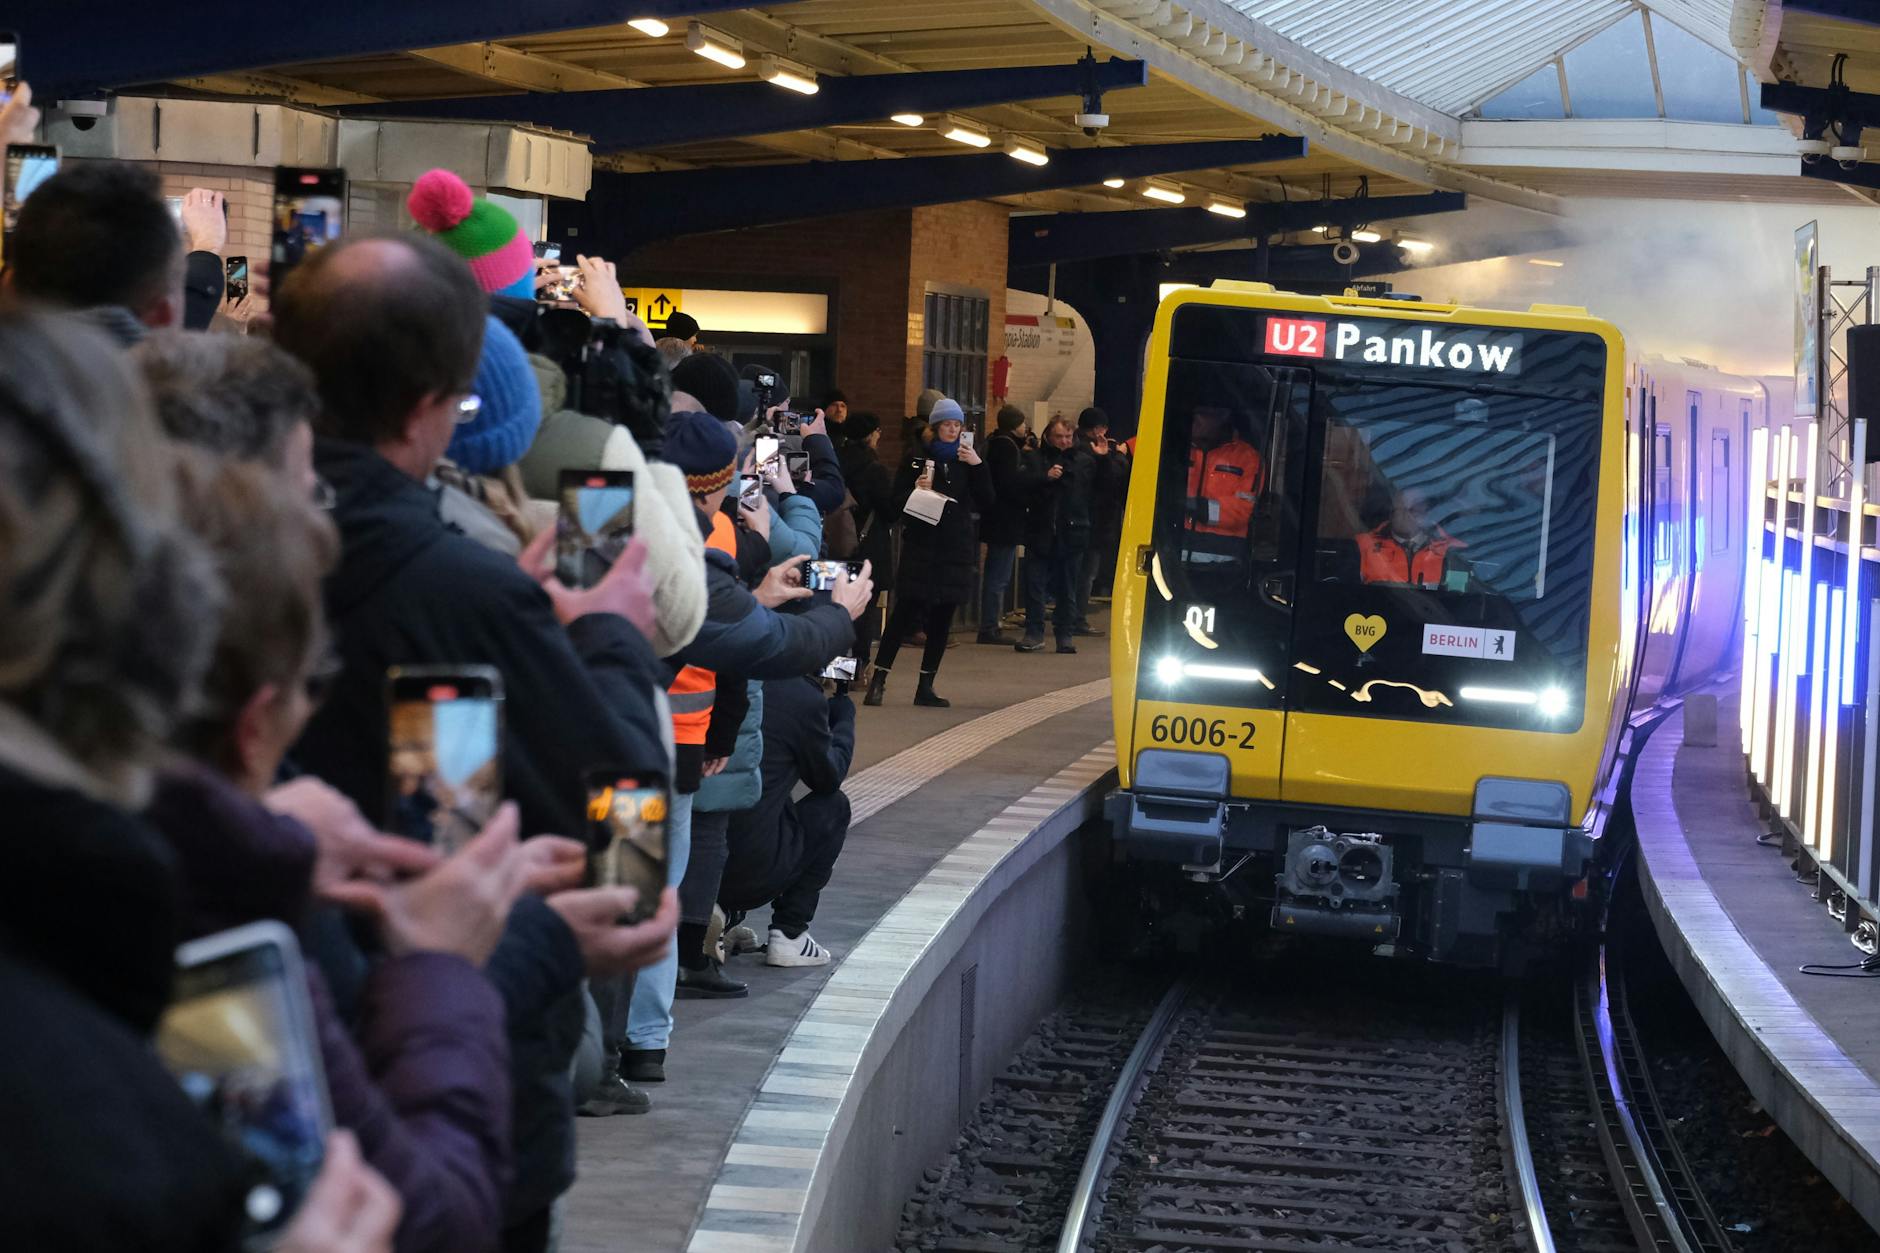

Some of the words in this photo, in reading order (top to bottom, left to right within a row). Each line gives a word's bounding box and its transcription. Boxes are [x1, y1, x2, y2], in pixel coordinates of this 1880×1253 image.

[1272, 323, 1317, 354] U2
[1335, 323, 1513, 372] Pankow
[1186, 606, 1216, 633] 01
[1355, 624, 1376, 637] BVG
[1429, 633, 1479, 649] BERLIN
[1151, 714, 1256, 750] 6006-2
